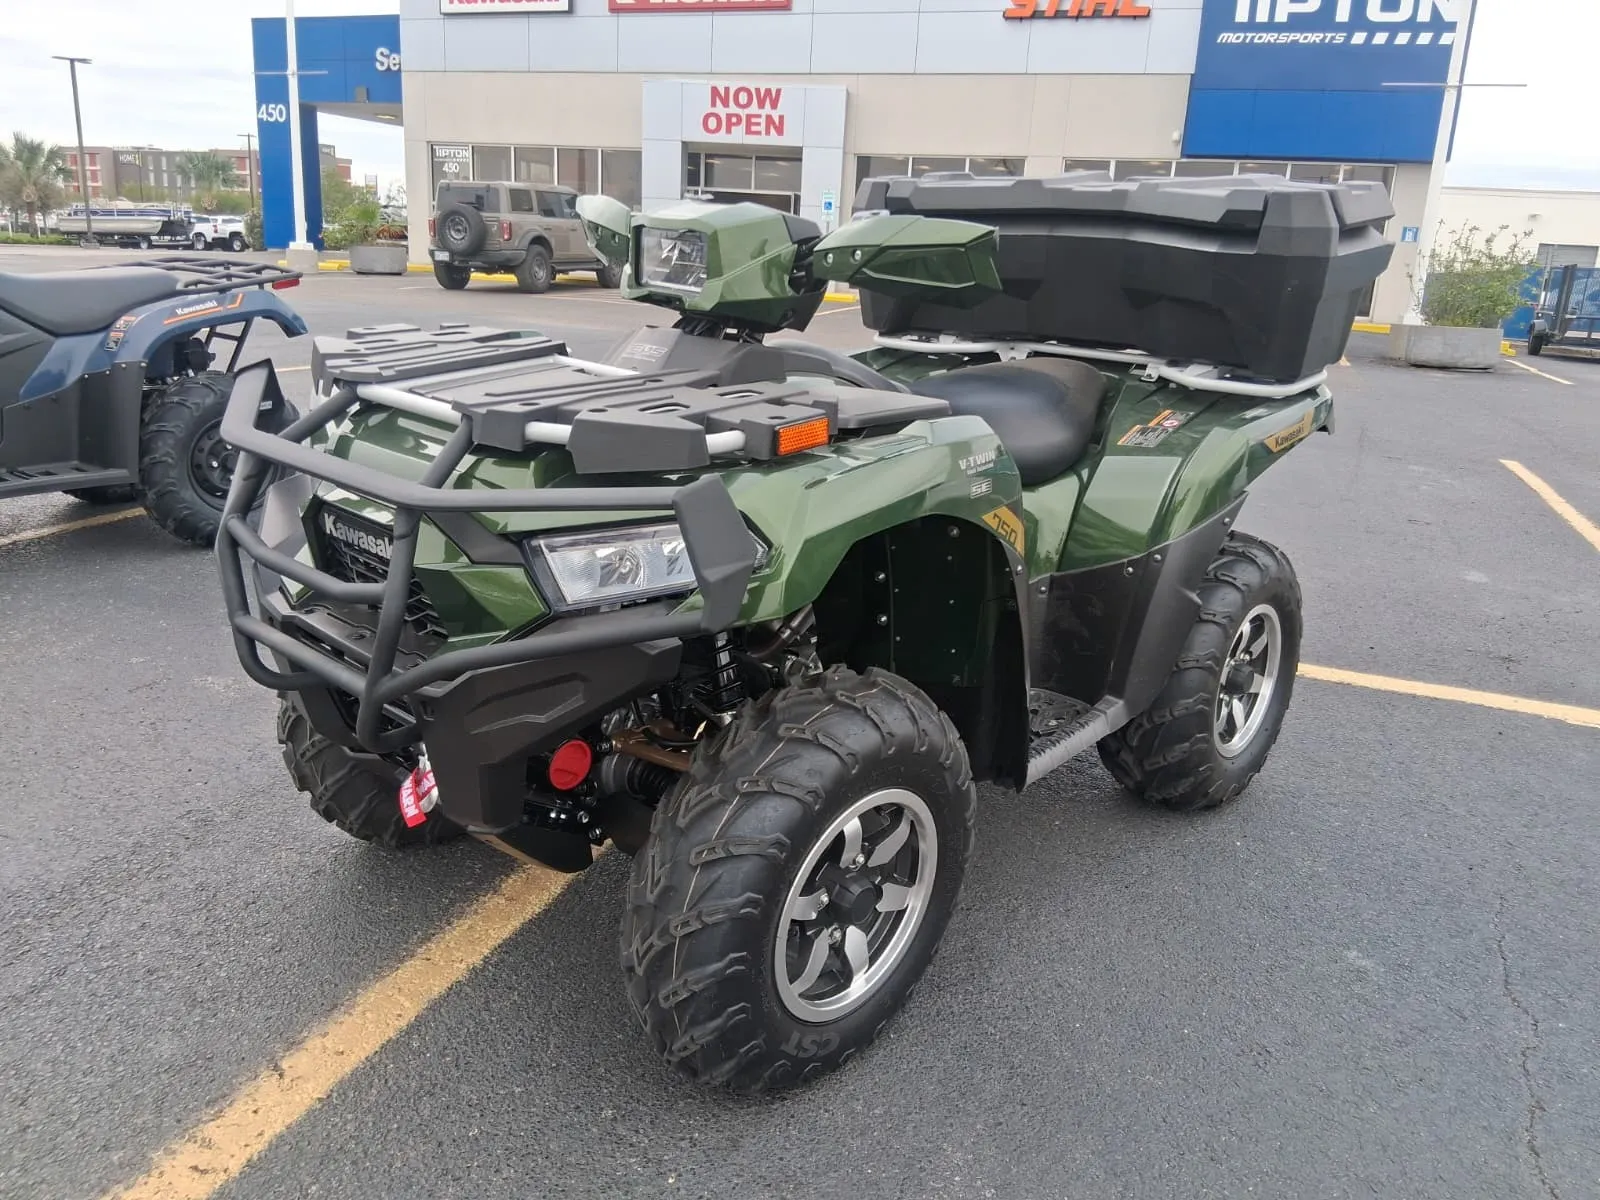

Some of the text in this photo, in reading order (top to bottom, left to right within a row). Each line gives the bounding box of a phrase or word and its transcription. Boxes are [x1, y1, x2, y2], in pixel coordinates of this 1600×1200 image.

[1217, 32, 1347, 43] MOTORSPORTS
[375, 47, 400, 71] Se
[710, 86, 782, 109] NOW
[258, 104, 286, 122] 450
[702, 112, 785, 136] OPEN
[433, 145, 469, 157] TIPTON
[442, 162, 460, 173] 450
[175, 300, 218, 315] Kawasaki
[1275, 423, 1304, 449] Kawasaki
[958, 450, 996, 470] V-TWIN
[324, 512, 393, 560] Kawasak
[992, 512, 1018, 546] 750
[780, 1031, 840, 1058] CST
